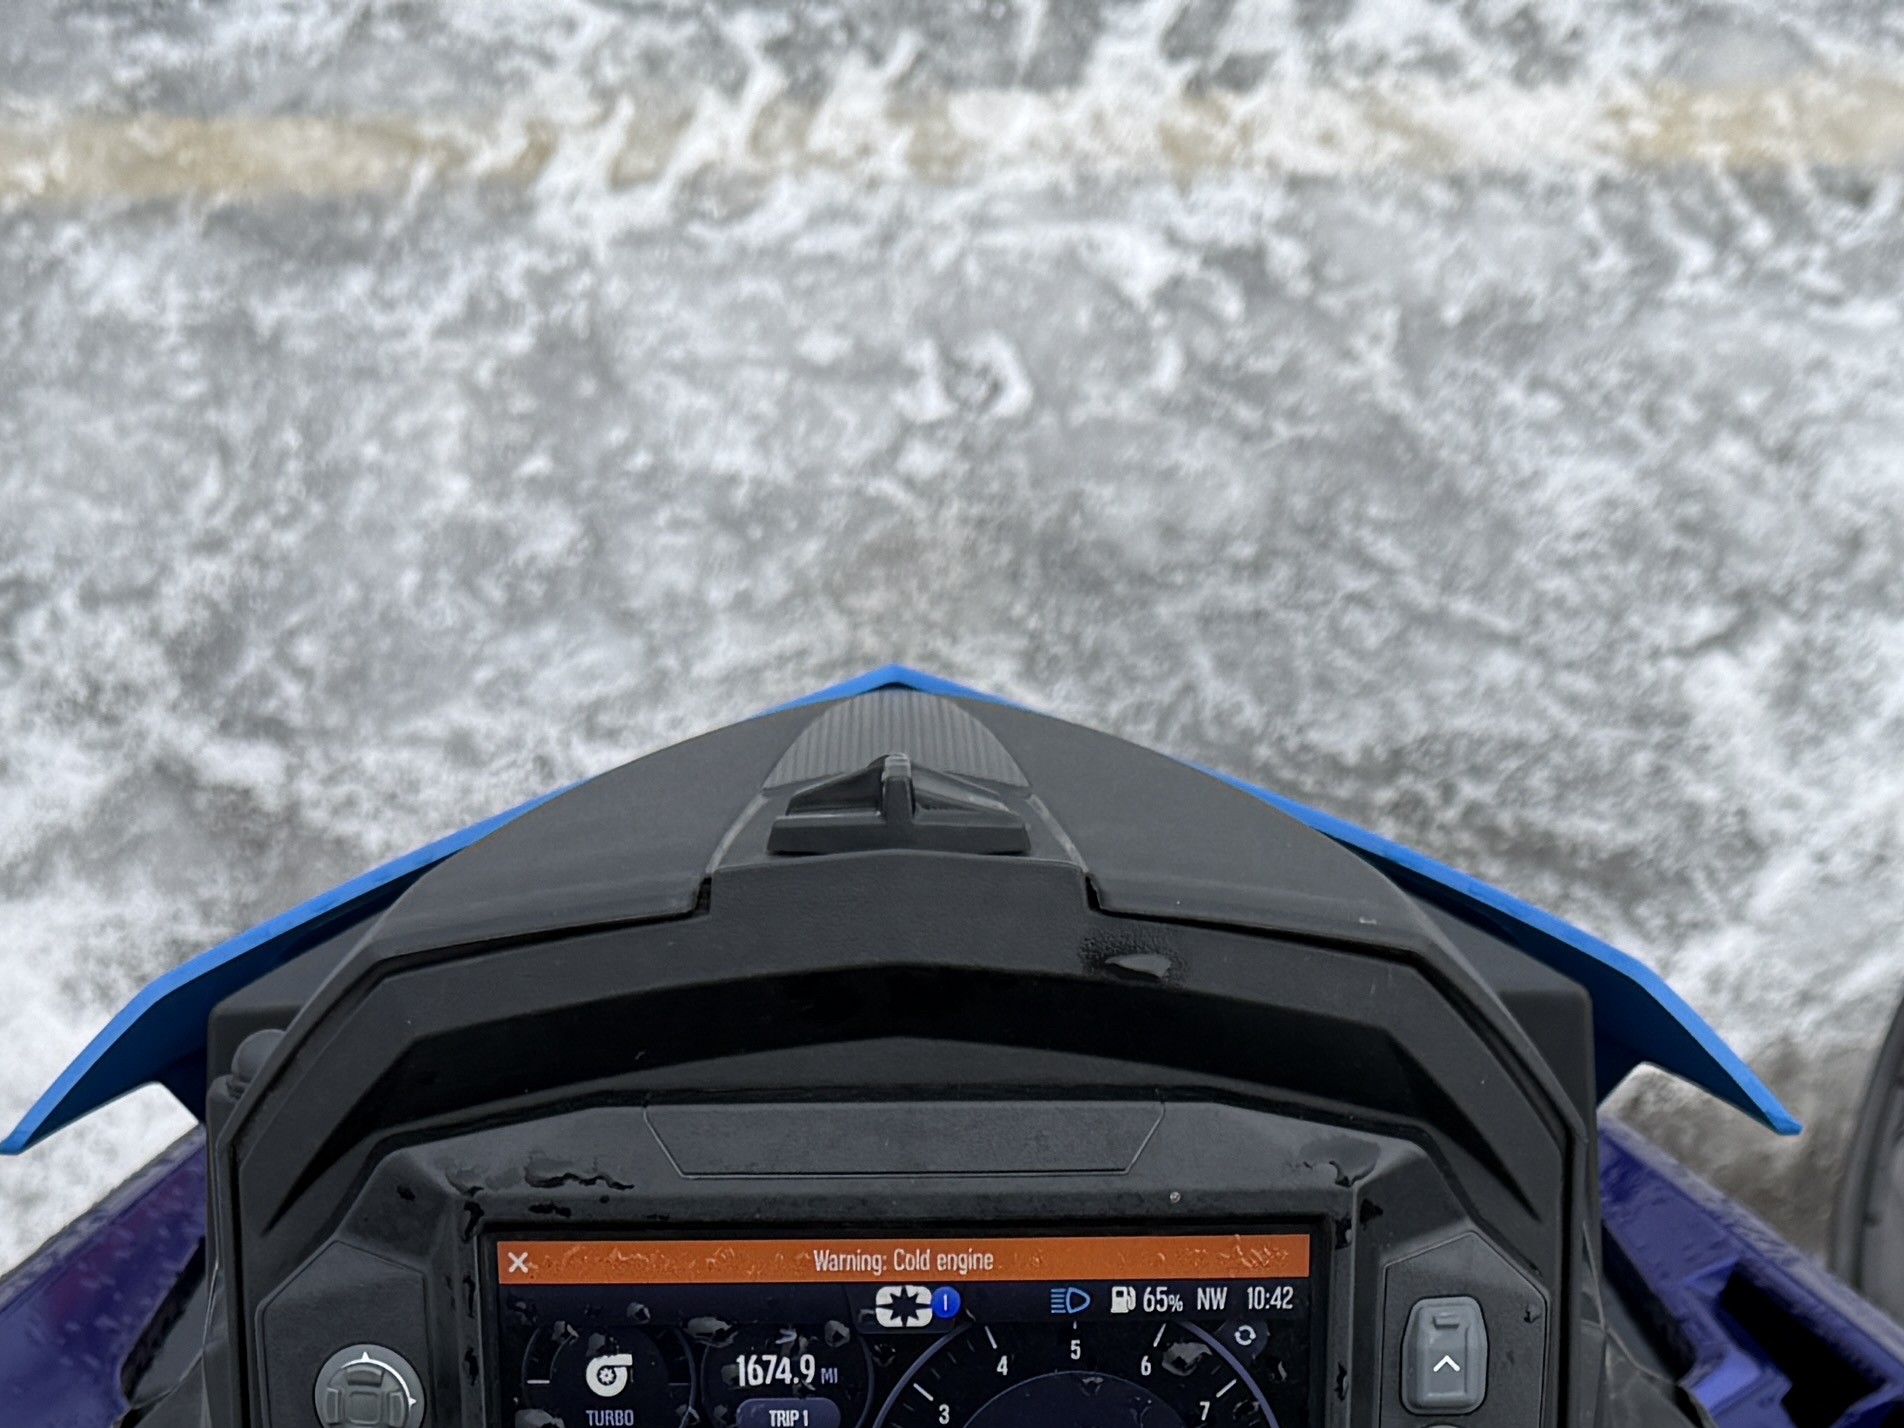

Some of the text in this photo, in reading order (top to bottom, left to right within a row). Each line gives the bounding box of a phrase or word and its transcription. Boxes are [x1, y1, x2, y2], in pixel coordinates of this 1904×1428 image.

[813, 1249, 994, 1276] Warning: Cold engine
[1143, 1287, 1183, 1312] 65%
[1197, 1288, 1227, 1310] NW
[1248, 1287, 1293, 1309] 10:42
[1071, 1341, 1081, 1359] 5
[736, 1354, 837, 1386] 1674.9 MI
[997, 1355, 1008, 1375] 4
[1141, 1356, 1151, 1375] 6
[586, 1410, 634, 1427] TURBO
[769, 1410, 809, 1427] TRIP 1
[939, 1405, 950, 1423] 3
[1200, 1402, 1209, 1420] 7
